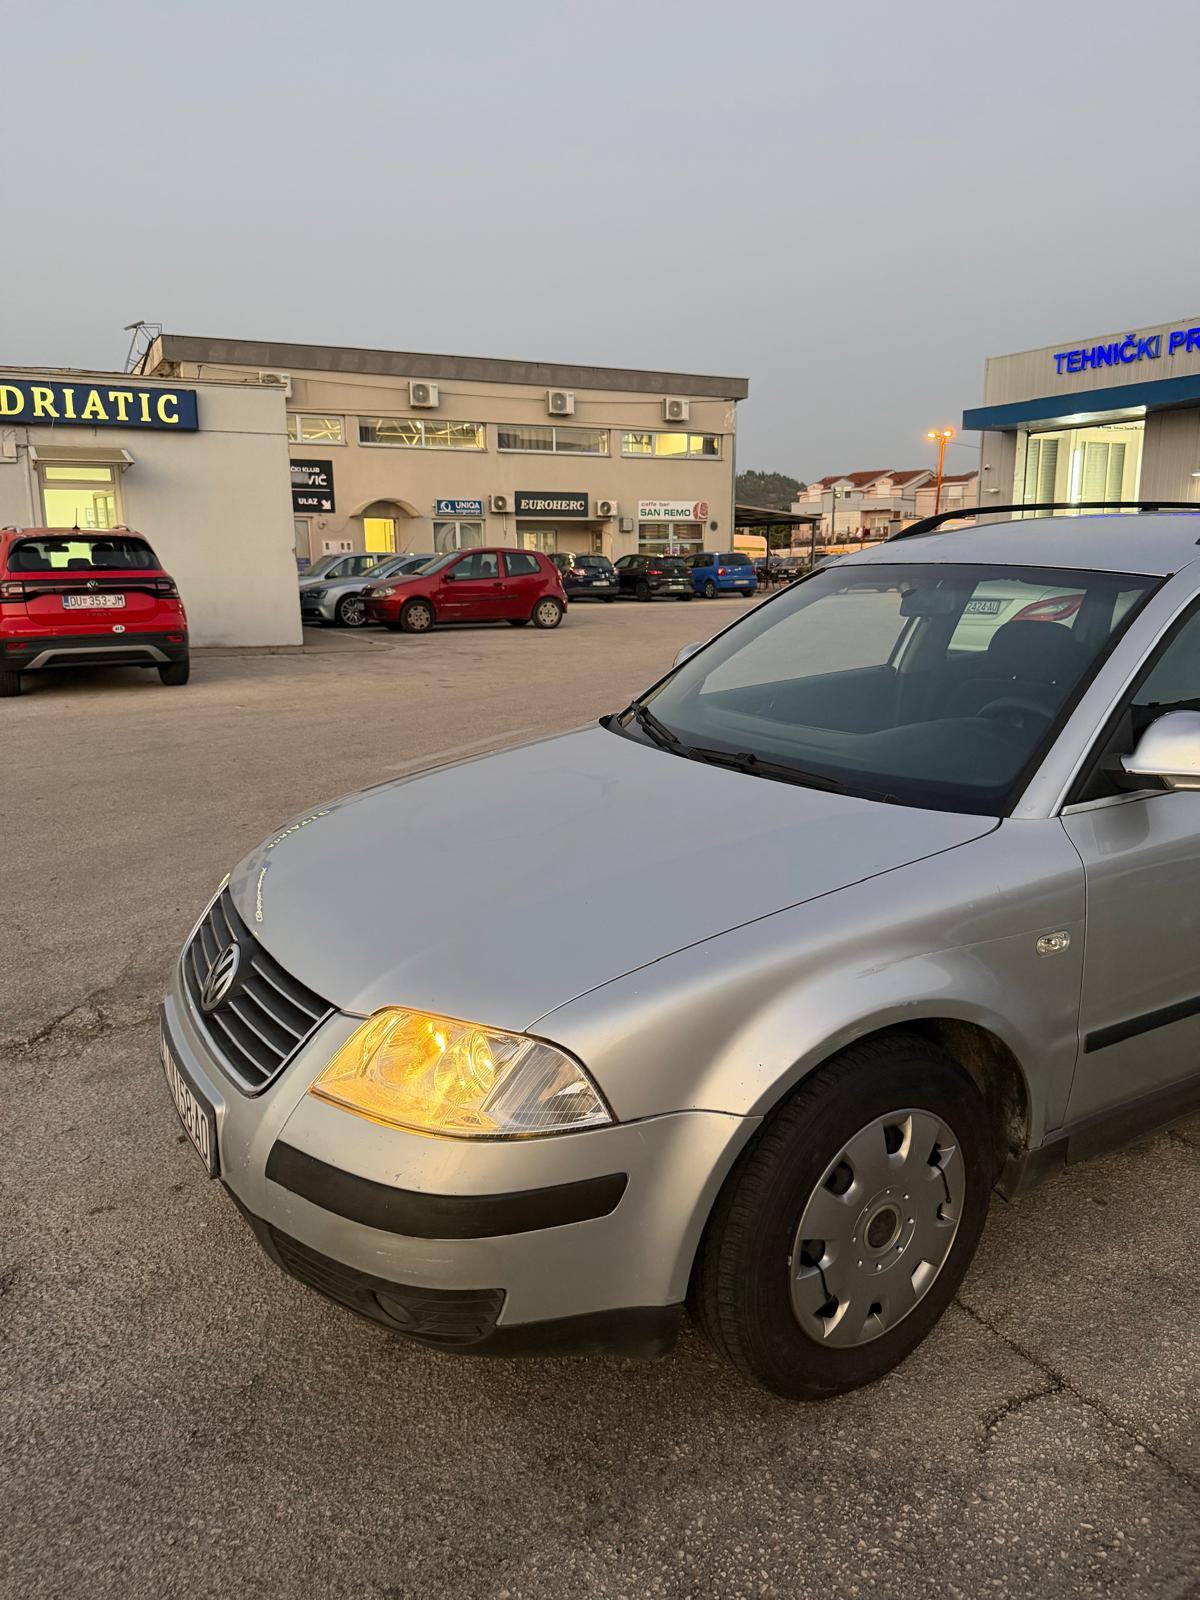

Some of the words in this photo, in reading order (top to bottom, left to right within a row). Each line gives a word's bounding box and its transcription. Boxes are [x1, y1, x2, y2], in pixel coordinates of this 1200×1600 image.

[1054, 334, 1163, 374] TEHNIČKI
[0, 385, 179, 424] DRIATIC
[455, 501, 480, 509] UNIQA
[520, 499, 585, 511] EUROHERC
[640, 509, 660, 517] SAN
[664, 509, 691, 517] REMO
